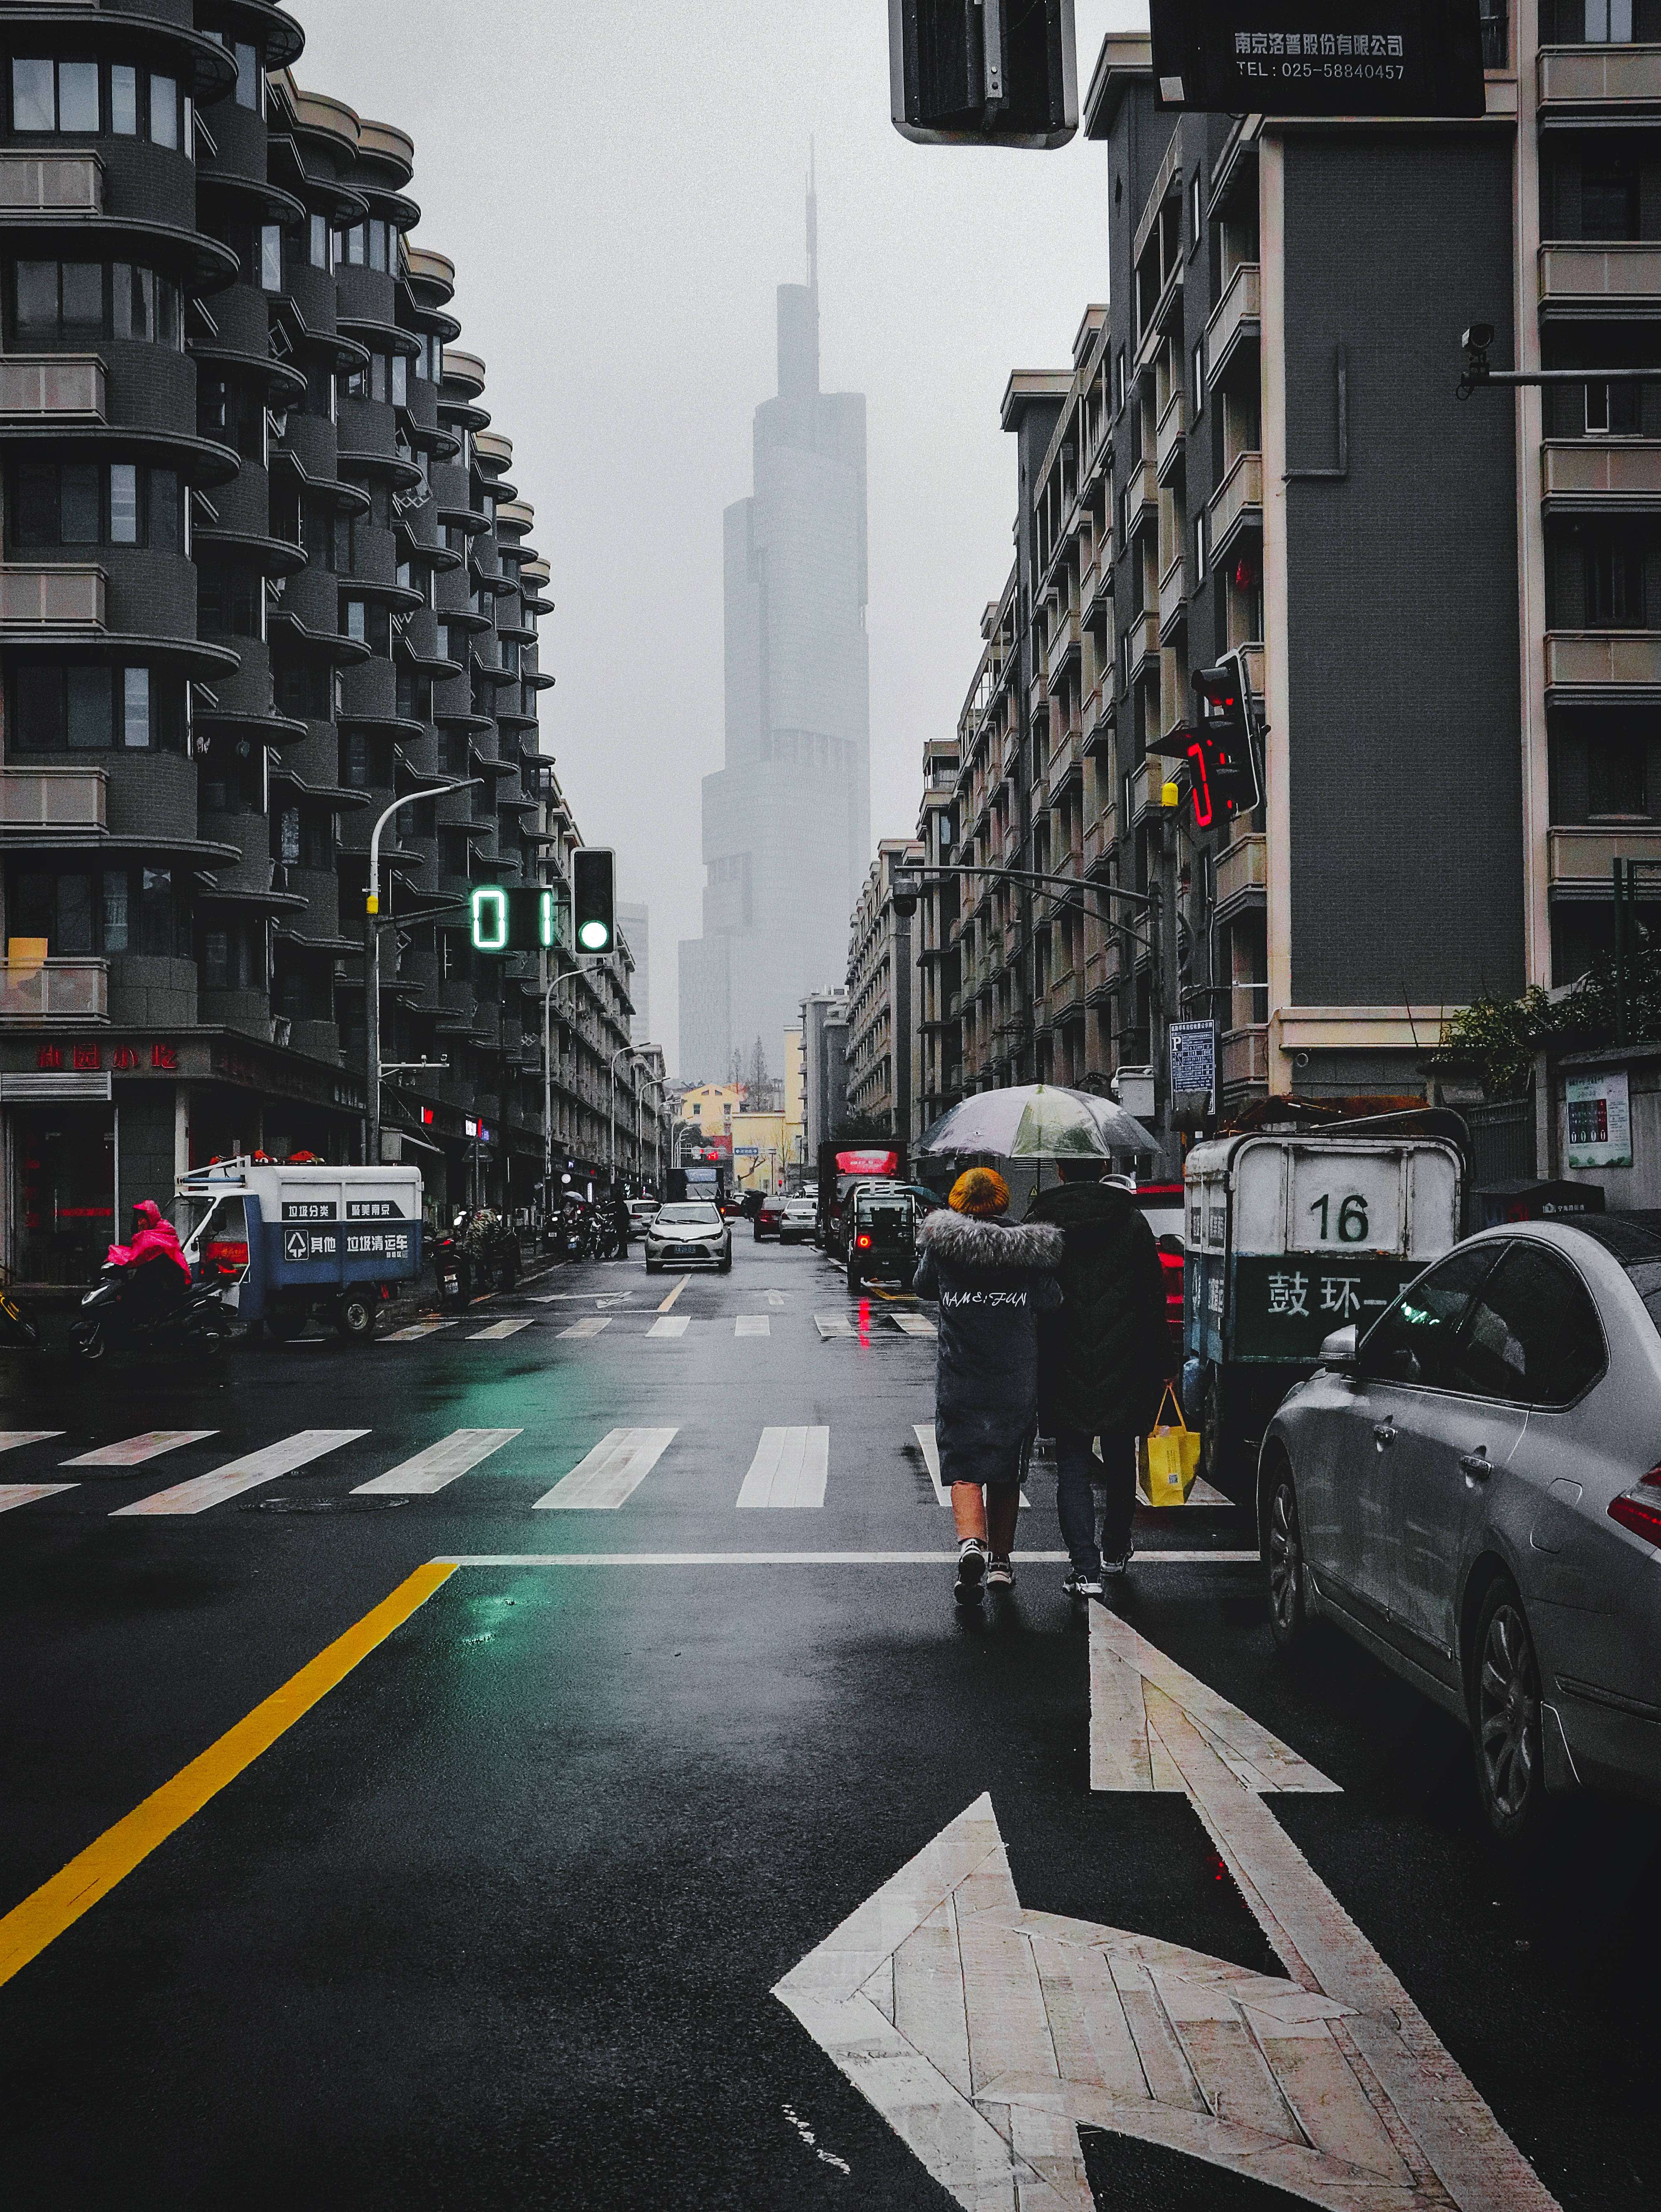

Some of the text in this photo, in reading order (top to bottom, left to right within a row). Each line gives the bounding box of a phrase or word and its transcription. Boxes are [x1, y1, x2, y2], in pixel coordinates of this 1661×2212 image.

[1235, 32, 1403, 56] 南京洛普股份有限公司
[1171, 1036, 1181, 1052] P
[289, 1205, 329, 1217] 垃圾分类
[1311, 1194, 1369, 1242] 16
[311, 1234, 408, 1253] 其他 垃圾清运车
[1268, 1271, 1413, 1318] 鼓环一
